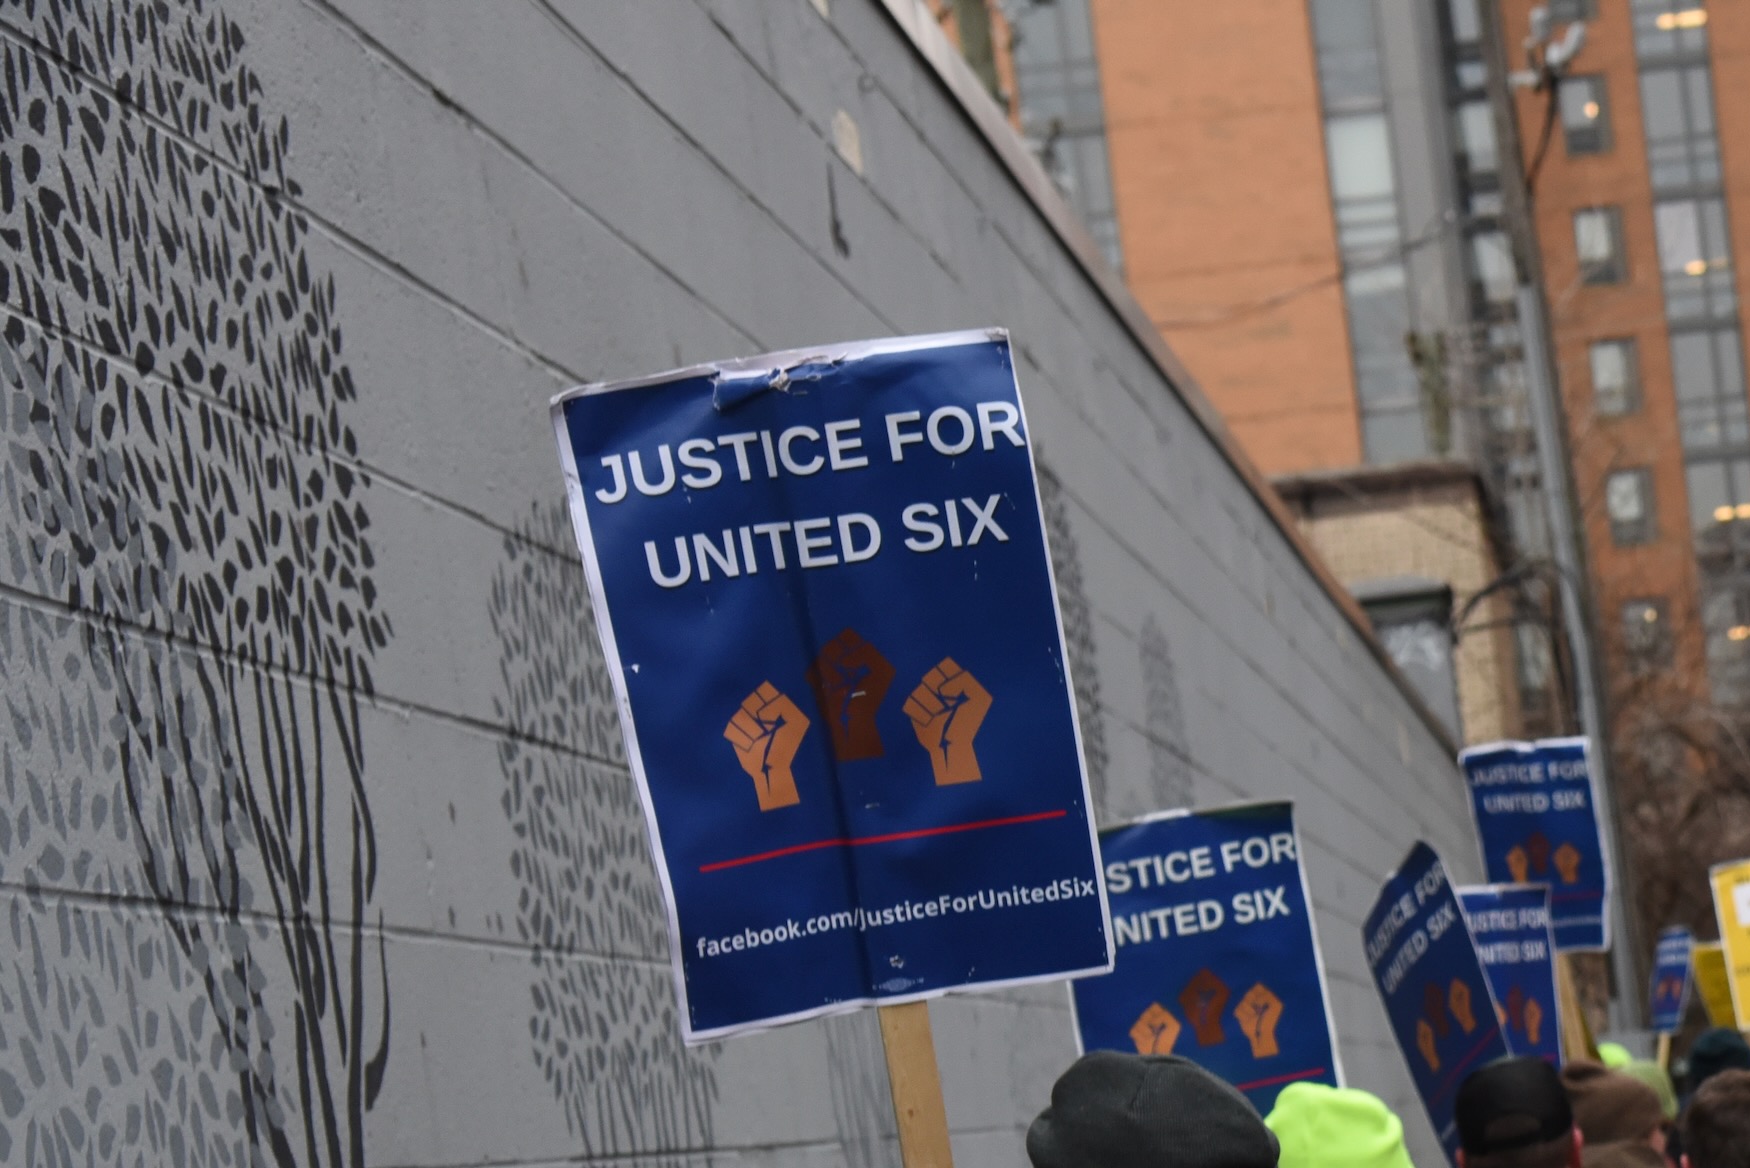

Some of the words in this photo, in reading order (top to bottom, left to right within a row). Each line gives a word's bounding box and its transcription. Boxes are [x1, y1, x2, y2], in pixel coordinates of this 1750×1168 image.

[595, 418, 868, 504] JUSTICE
[885, 400, 1026, 462] FOR
[644, 512, 881, 588] UNITED
[901, 494, 1009, 552] SIX
[1483, 792, 1550, 813] UNITED
[1552, 789, 1585, 811] SIX
[1105, 846, 1216, 893] STICE
[1220, 832, 1297, 873] FOR
[697, 876, 1095, 958] facebook.com/JusticeForUnitedSix
[1113, 899, 1224, 946] NITED
[1232, 886, 1290, 925] SIX
[1479, 941, 1520, 964] NITED
